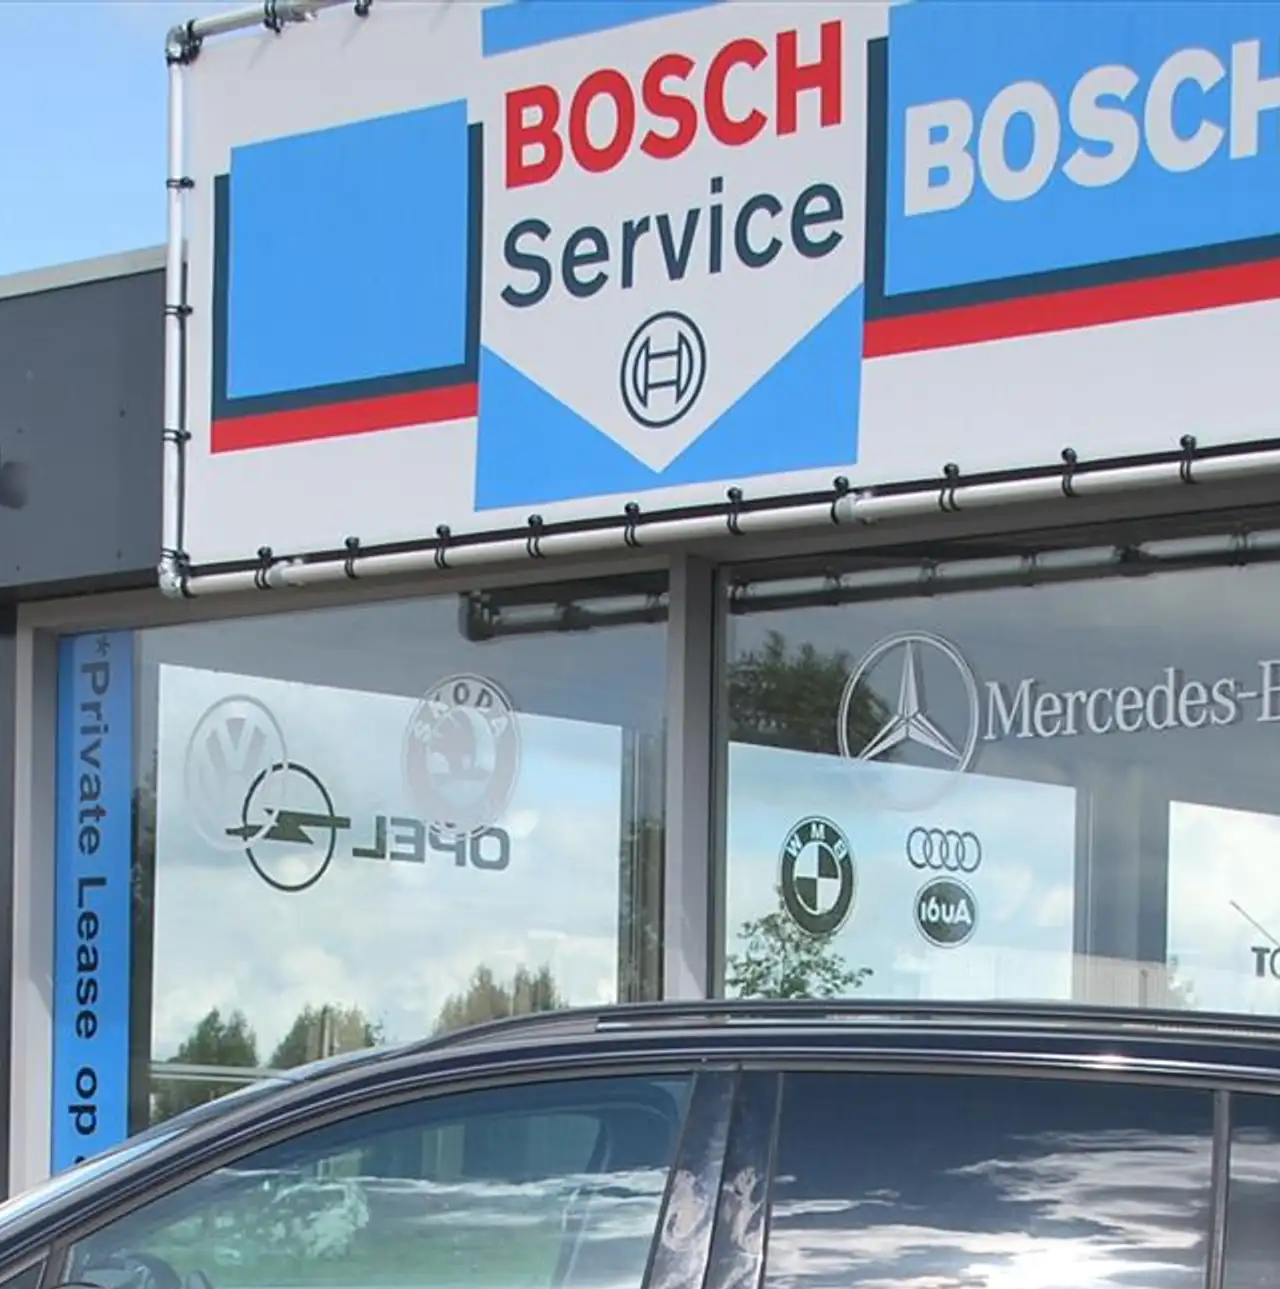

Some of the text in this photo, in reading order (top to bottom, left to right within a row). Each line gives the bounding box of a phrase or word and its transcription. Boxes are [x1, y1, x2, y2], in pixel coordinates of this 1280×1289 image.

[505, 20, 842, 188] BOSCH
[500, 176, 844, 308] Service
[75, 876, 107, 1040] Lease
[67, 1066, 97, 1136] op
